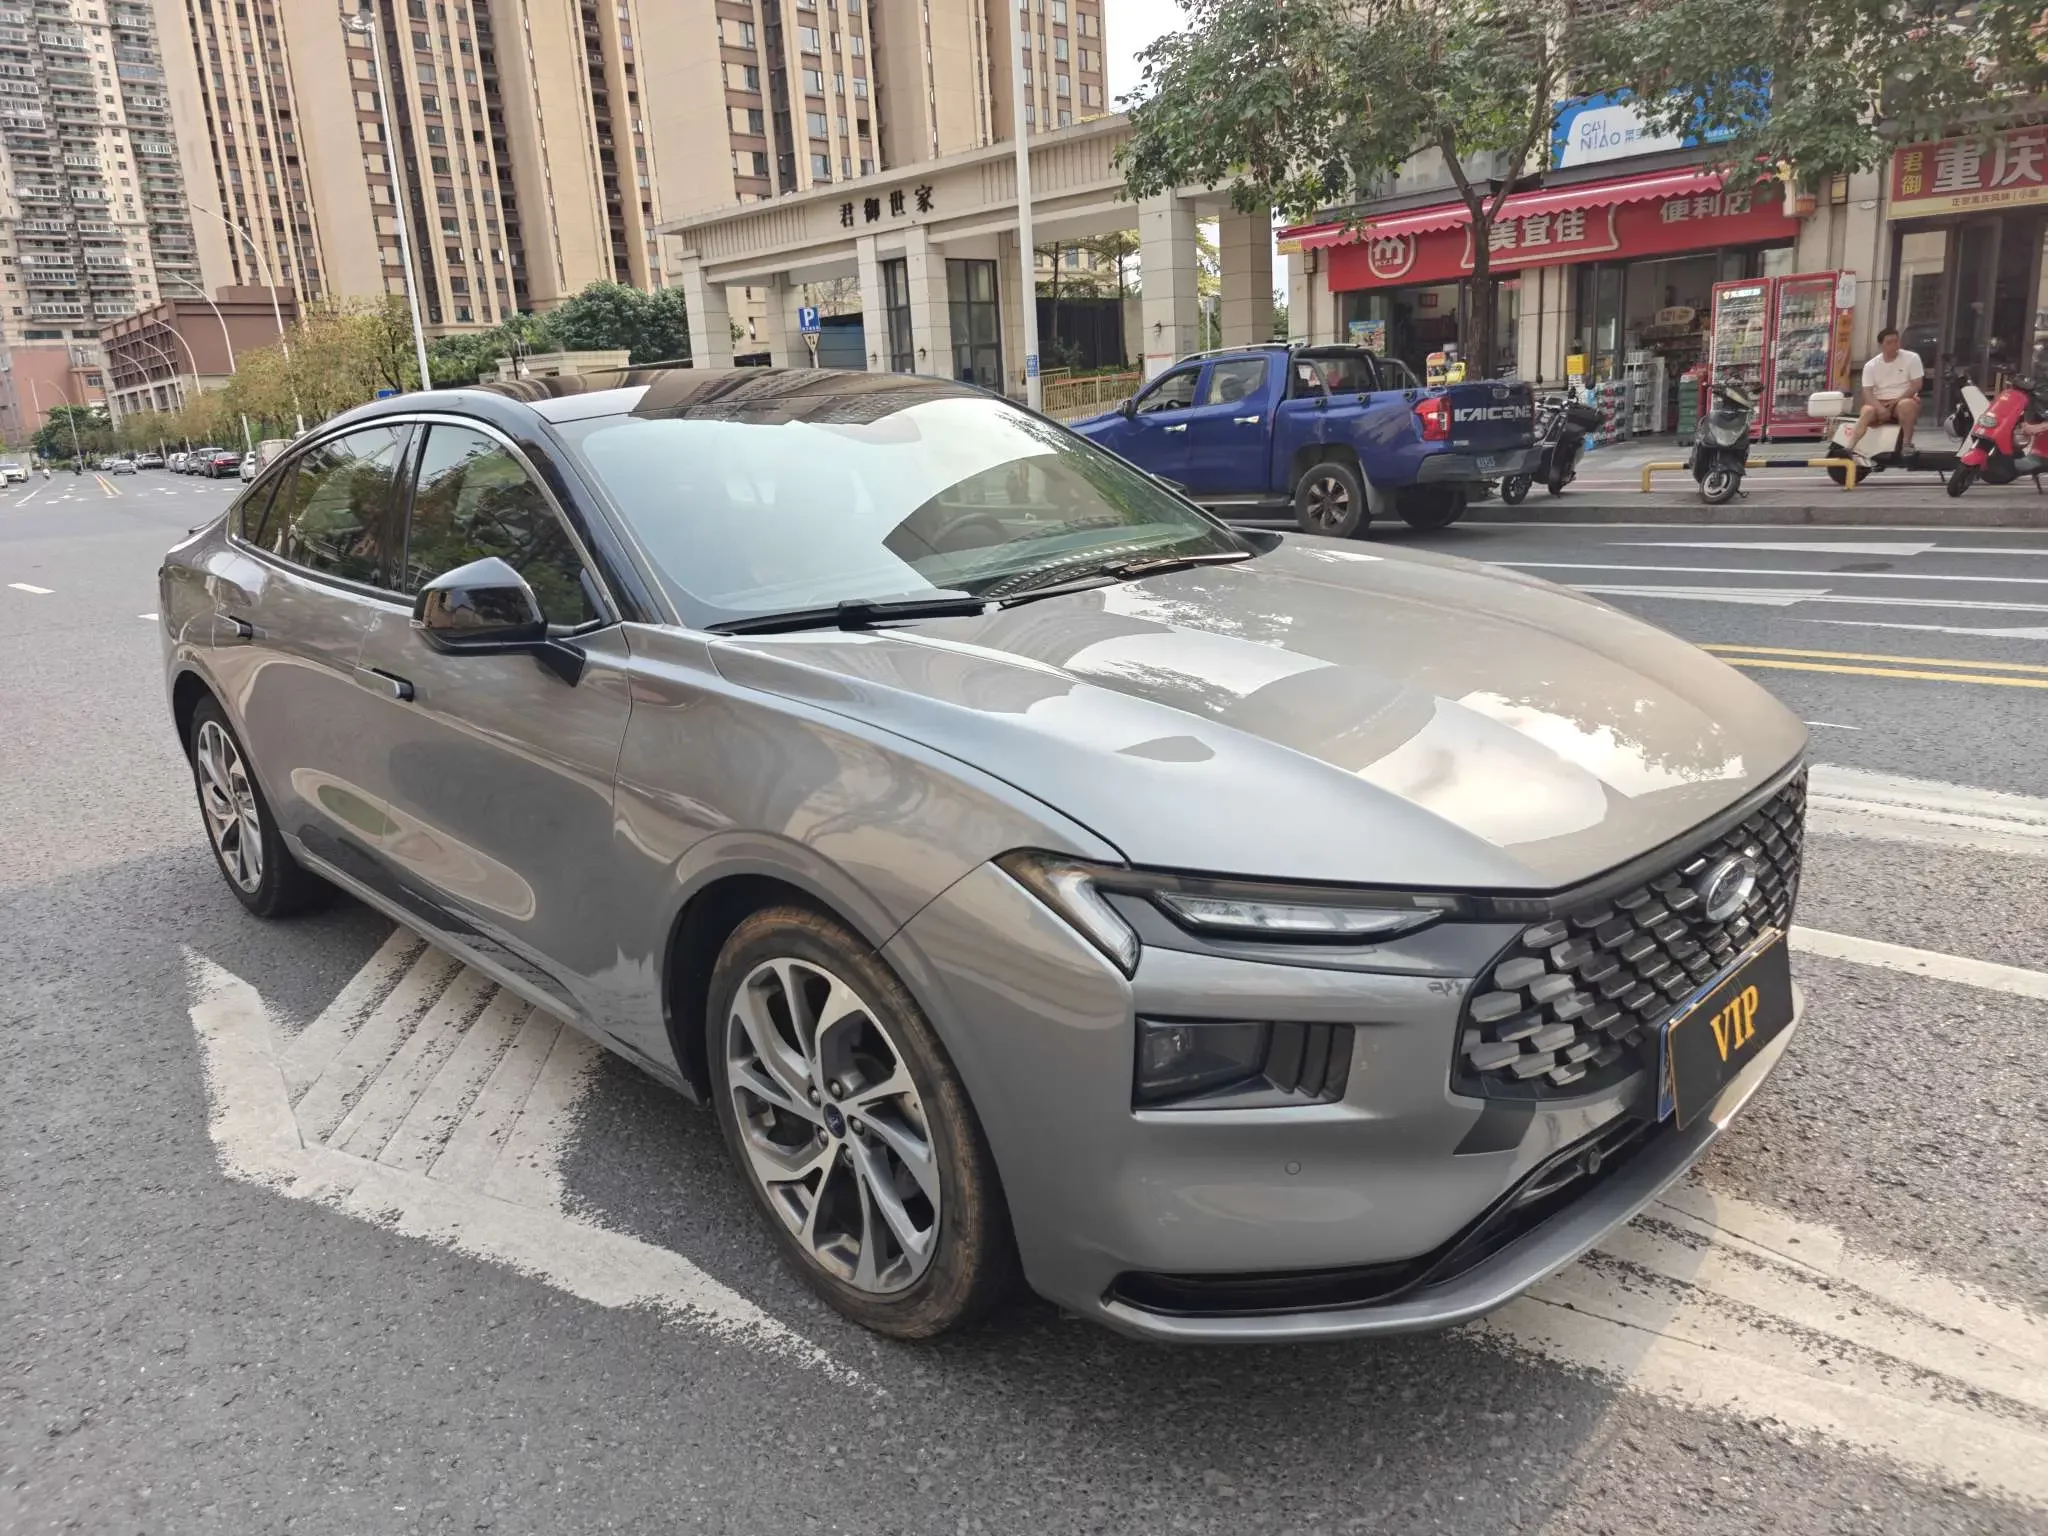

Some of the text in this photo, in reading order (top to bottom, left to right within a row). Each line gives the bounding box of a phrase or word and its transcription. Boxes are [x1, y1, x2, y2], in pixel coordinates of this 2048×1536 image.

[1931, 136, 2047, 193] 重庆
[839, 184, 935, 228] 君御世家
[1659, 189, 1753, 224] 便利店
[1489, 210, 1585, 250] 美宜佳
[803, 308, 815, 327] P
[1454, 405, 1532, 421] KAICENE
[1709, 984, 1759, 1062] VIP
